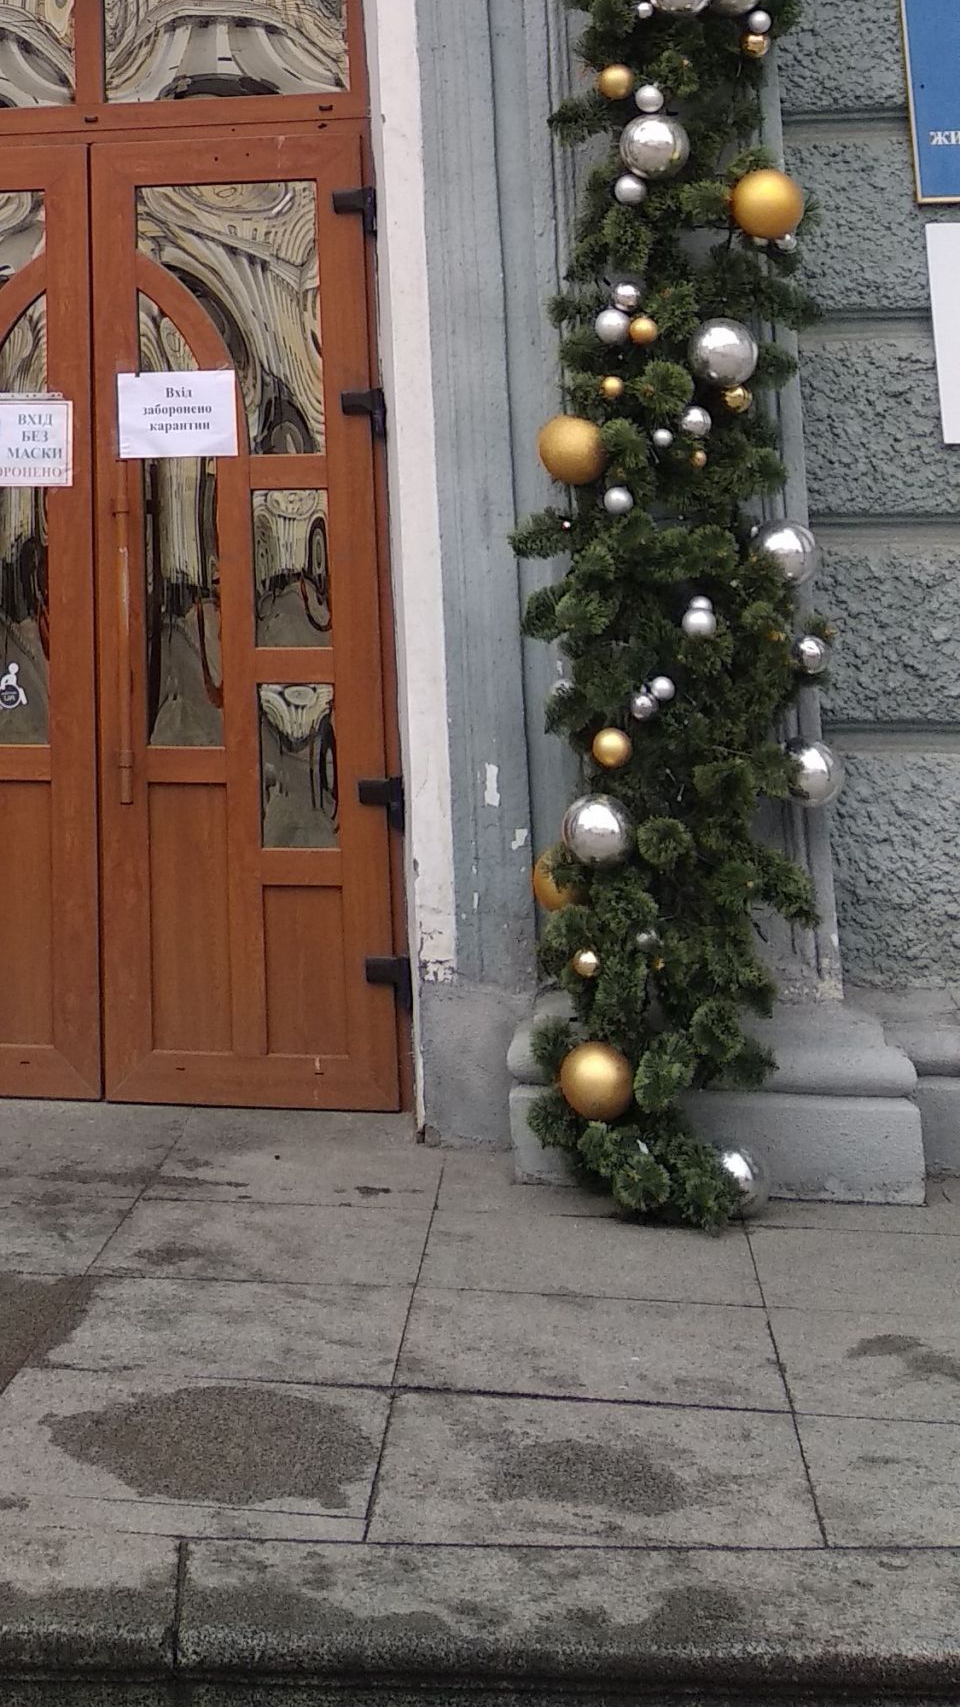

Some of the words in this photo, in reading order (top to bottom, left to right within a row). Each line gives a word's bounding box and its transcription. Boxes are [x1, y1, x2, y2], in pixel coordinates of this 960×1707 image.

[165, 387, 192, 398] Вхід
[142, 404, 212, 417] заборонено
[17, 413, 53, 427] ВХІД
[149, 421, 210, 434] карантин
[21, 430, 49, 443] БЕЗ
[6, 447, 62, 460] МАСКИ
